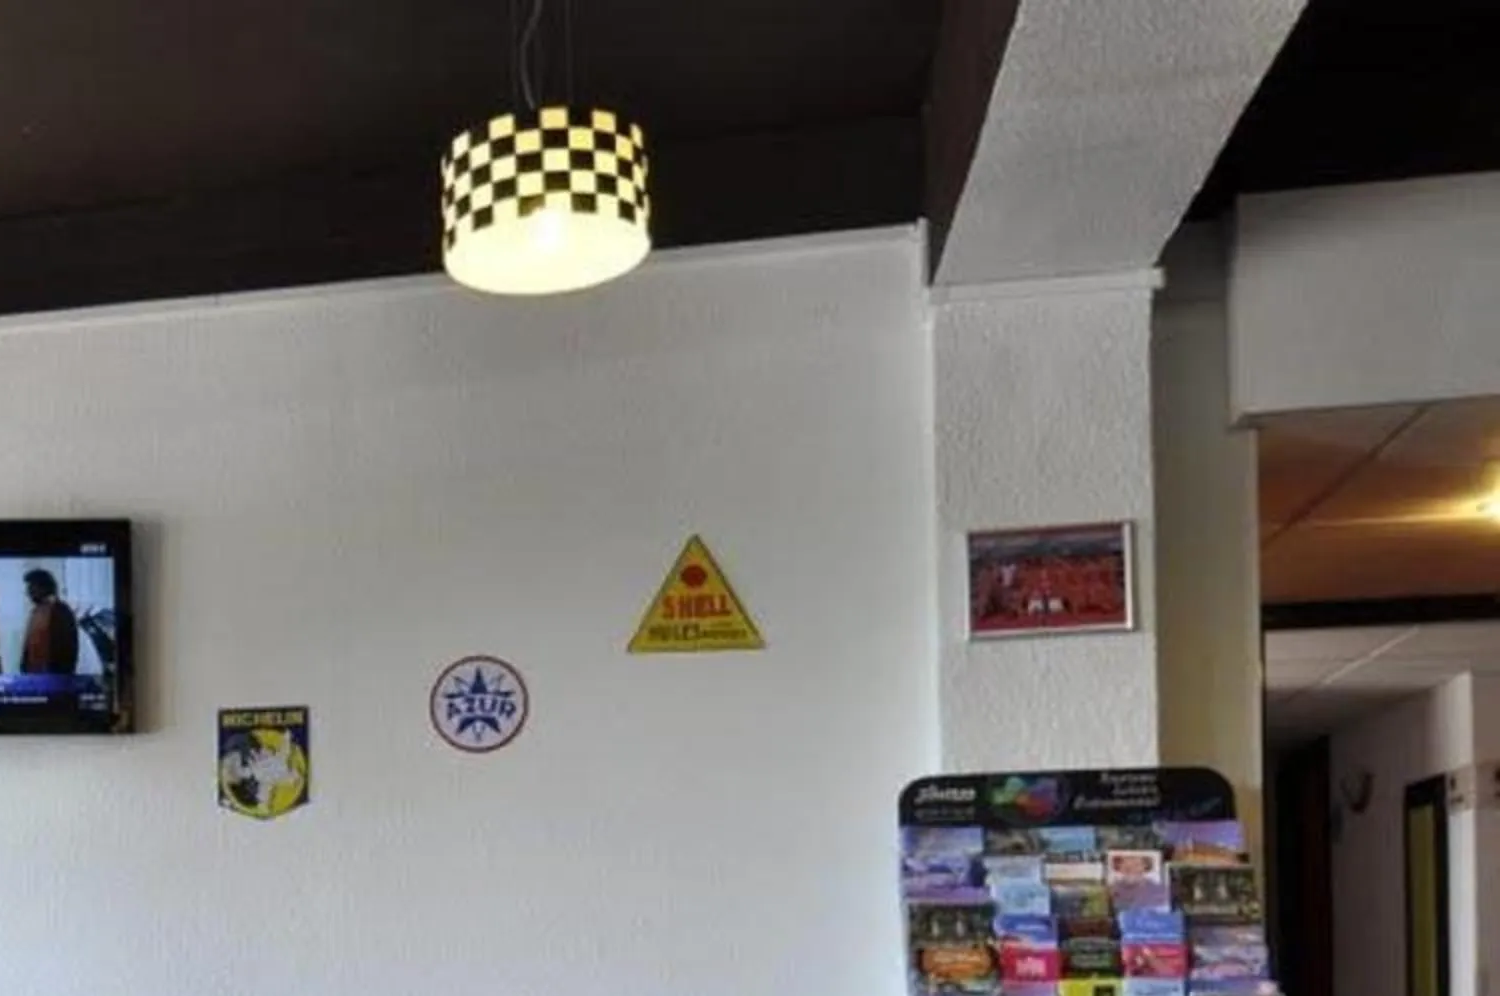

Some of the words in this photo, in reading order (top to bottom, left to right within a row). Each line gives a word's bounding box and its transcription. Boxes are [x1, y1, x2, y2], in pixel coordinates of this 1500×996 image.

[662, 594, 731, 619] SHELL
[222, 711, 304, 727] MICHELIN
[446, 696, 518, 720] AZUR
